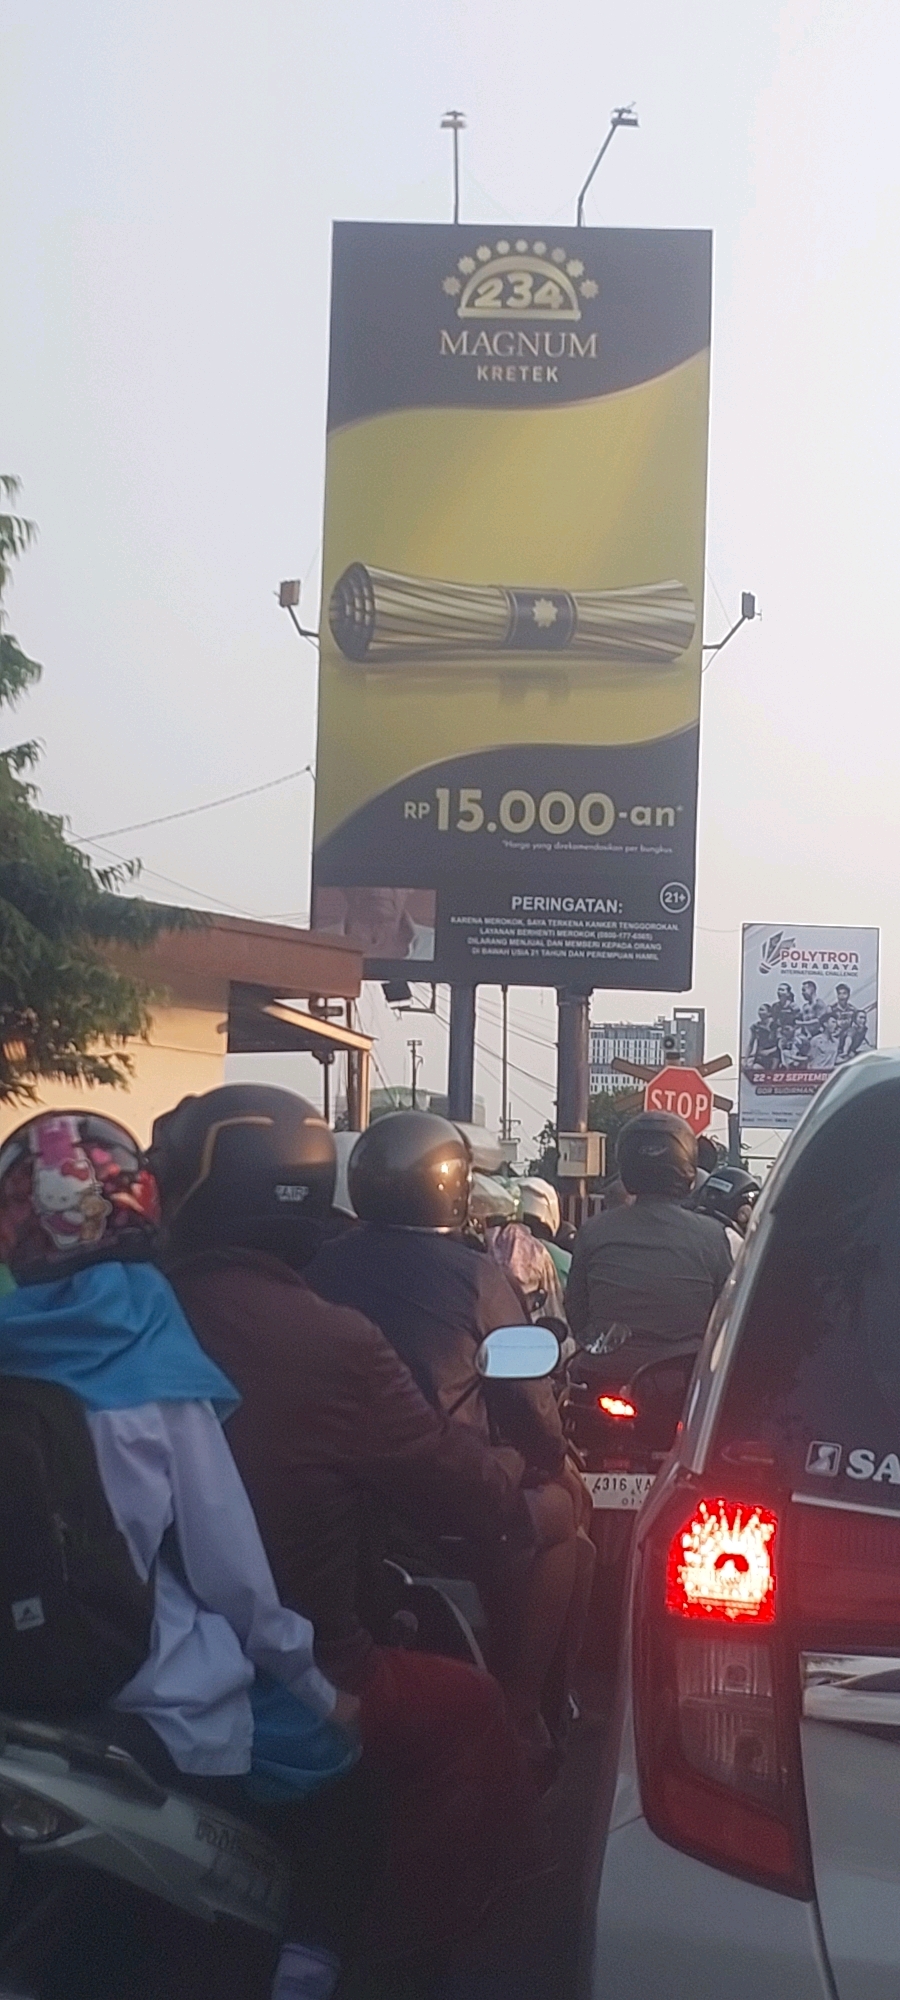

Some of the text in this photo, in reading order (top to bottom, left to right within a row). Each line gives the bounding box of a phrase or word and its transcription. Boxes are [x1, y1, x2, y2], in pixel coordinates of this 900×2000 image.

[474, 270, 564, 310] 234
[440, 329, 598, 359] MAGNUM
[477, 365, 559, 383] KRETEK
[533, 842, 552, 851] yang
[554, 841, 623, 852] direkomendasikan
[625, 845, 638, 853] per
[640, 844, 672, 854] bungkus
[664, 891, 686, 903] 21+
[511, 896, 623, 913] PERINGATAN:
[450, 916, 483, 924] KARENA
[548, 919, 584, 928] TERKENA
[585, 921, 618, 929] KANKER
[480, 927, 515, 936] LAYANAN
[517, 929, 555, 937] BERHENTI
[557, 930, 595, 938] MEROKOK
[467, 937, 661, 951] DILARANG MENJUAL DAN MEMBERI KEPADA ORANG
[482, 947, 510, 956] BAWAH
[541, 949, 567, 957] TAHUN
[587, 951, 634, 959] PEREMPUAN
[781, 962, 859, 971] SURABAYA
[753, 1074, 765, 1082] 22
[773, 1074, 785, 1082] 27
[651, 1089, 708, 1120] STOP
